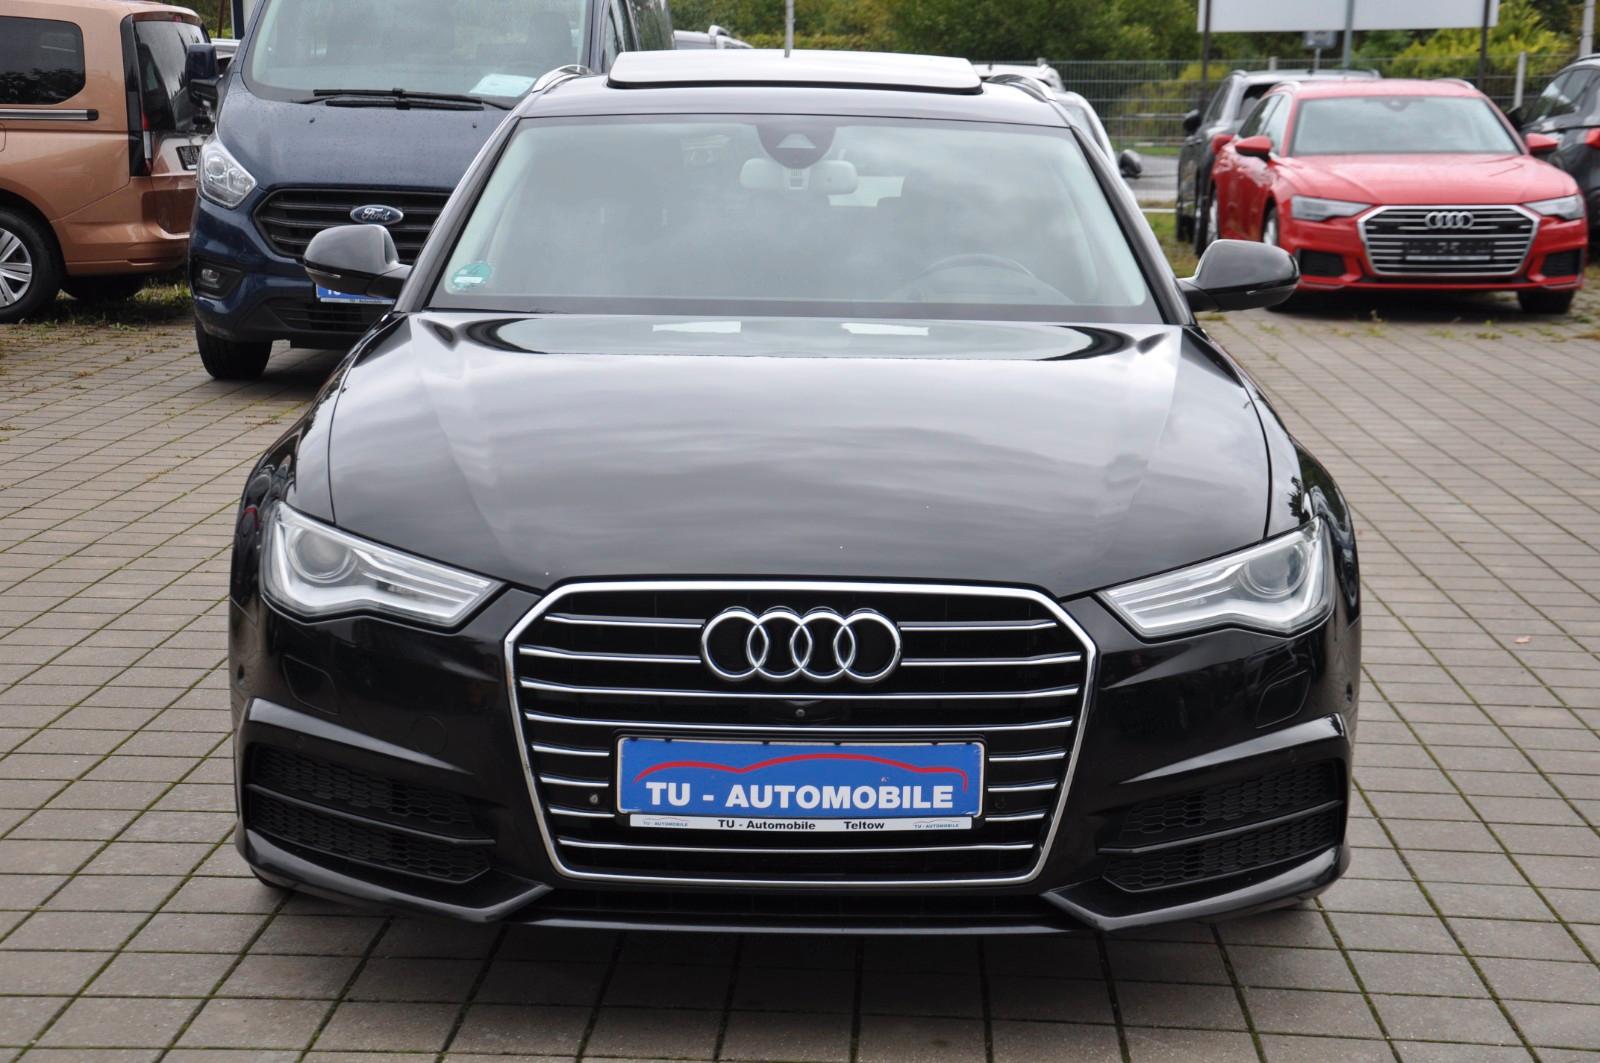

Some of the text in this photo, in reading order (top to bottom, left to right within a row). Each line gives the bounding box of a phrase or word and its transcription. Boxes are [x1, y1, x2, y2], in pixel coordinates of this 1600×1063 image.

[646, 782, 690, 806] TU
[725, 784, 953, 809] AUTOMOBILE
[717, 819, 735, 828] TU
[747, 820, 816, 830] Automobile
[843, 821, 885, 830] Teltow
